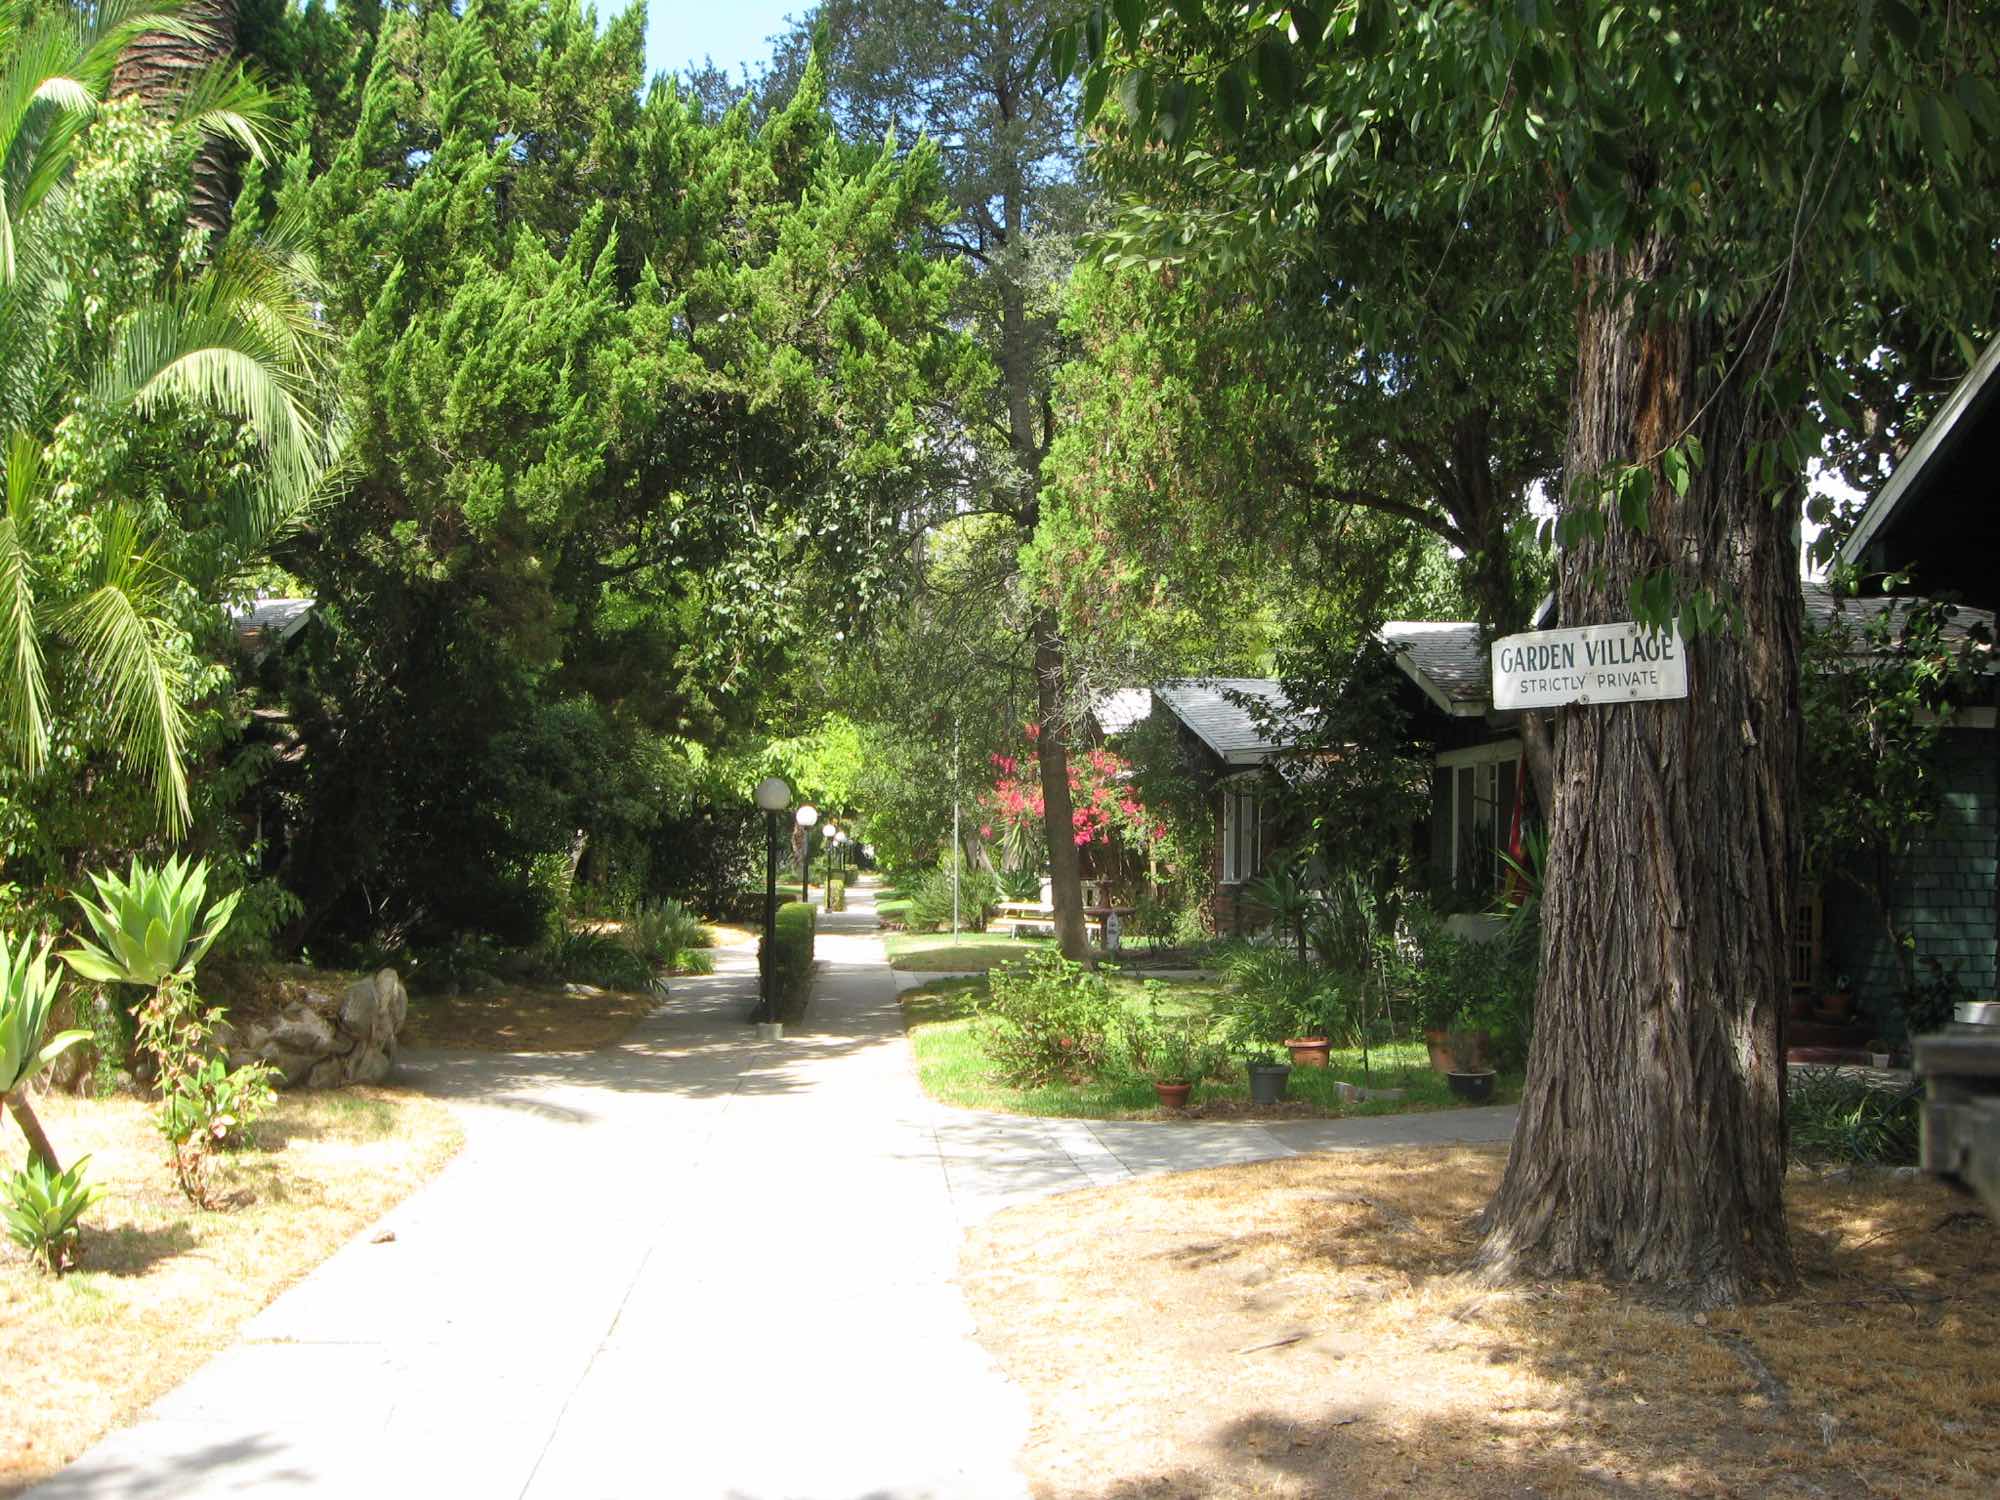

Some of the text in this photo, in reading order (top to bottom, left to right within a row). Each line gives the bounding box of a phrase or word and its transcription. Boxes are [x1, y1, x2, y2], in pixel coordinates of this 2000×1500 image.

[1501, 635, 1674, 673] GARDEN VILLAGE
[1520, 671, 1657, 694] STRICTLY PRIVATE
